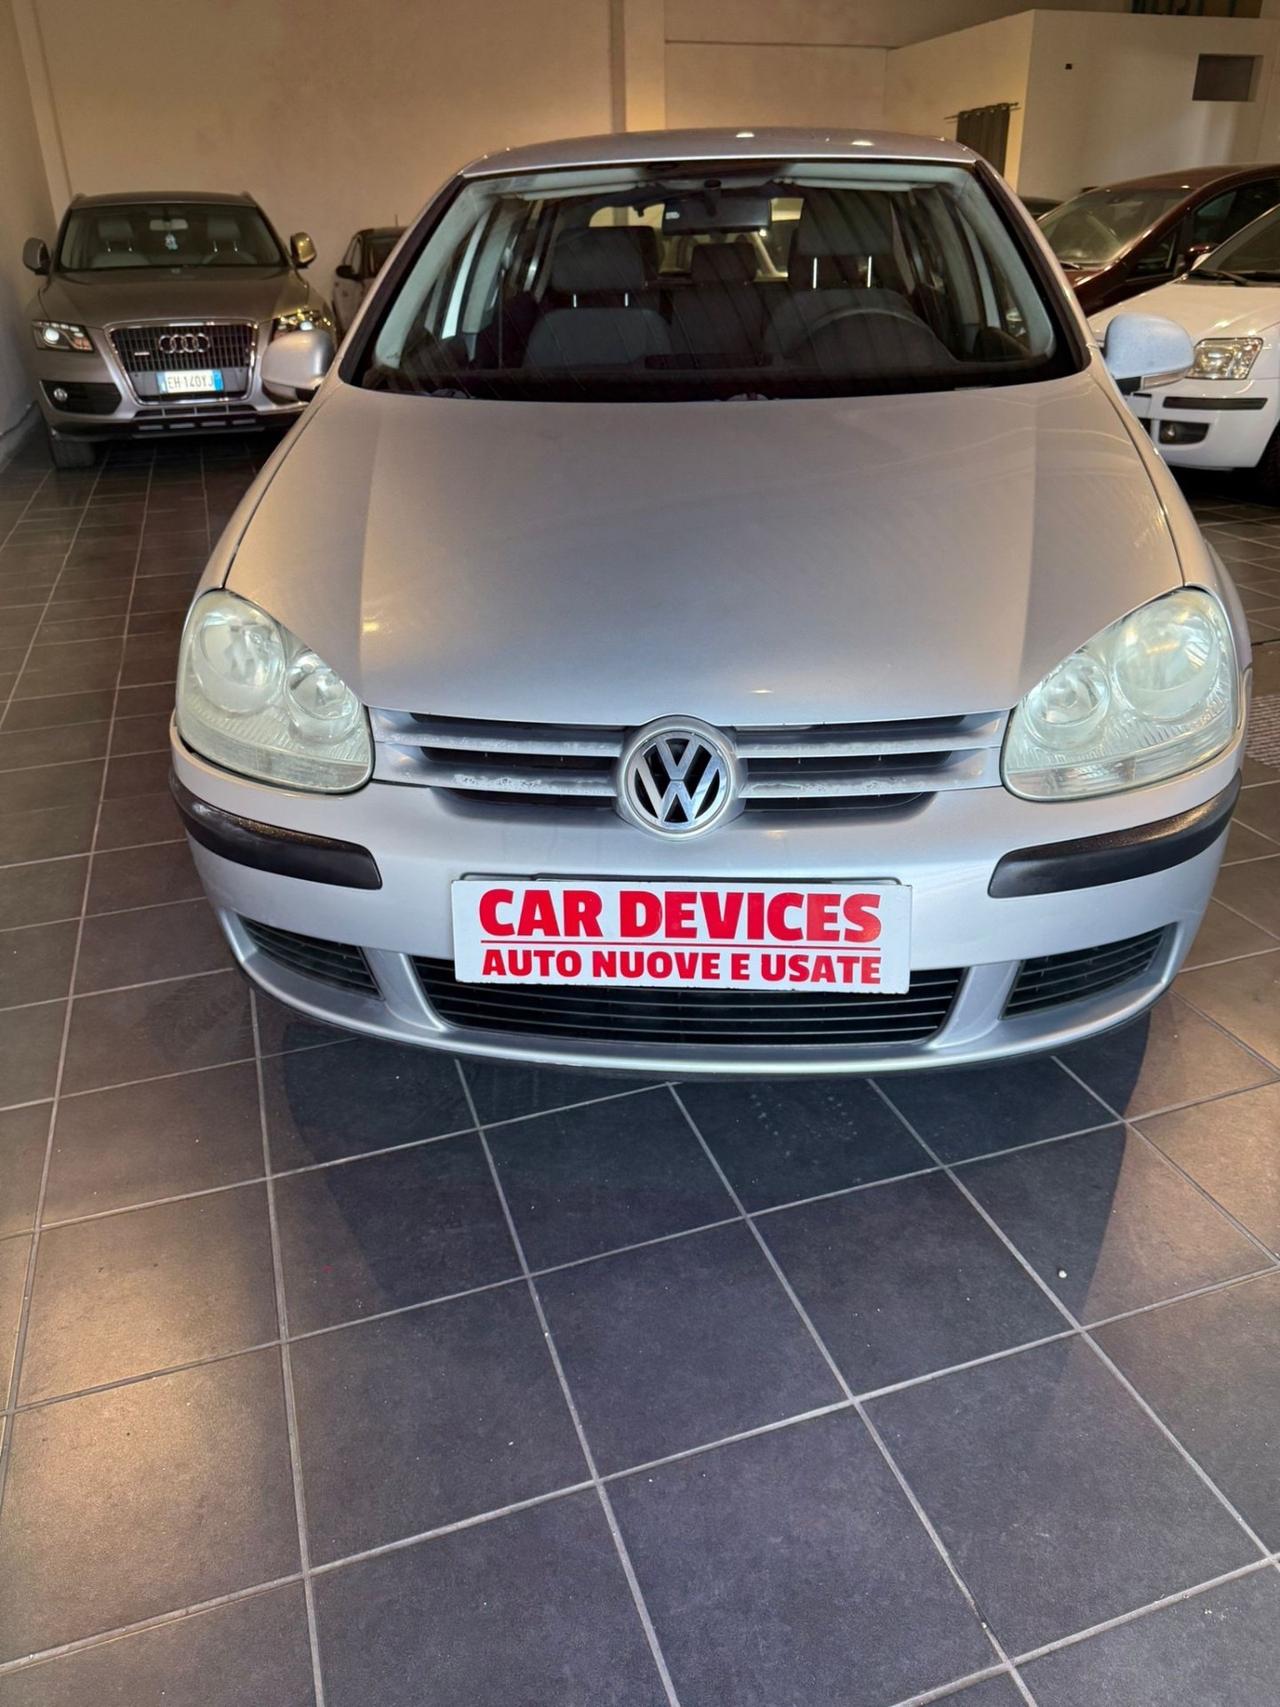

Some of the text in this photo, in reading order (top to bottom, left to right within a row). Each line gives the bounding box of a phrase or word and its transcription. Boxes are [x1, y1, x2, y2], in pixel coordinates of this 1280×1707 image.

[167, 376, 181, 389] EH
[627, 731, 727, 830] VW
[479, 888, 881, 944] CAR DEVICES
[482, 949, 881, 985] AUTO NUOVE E USATE
